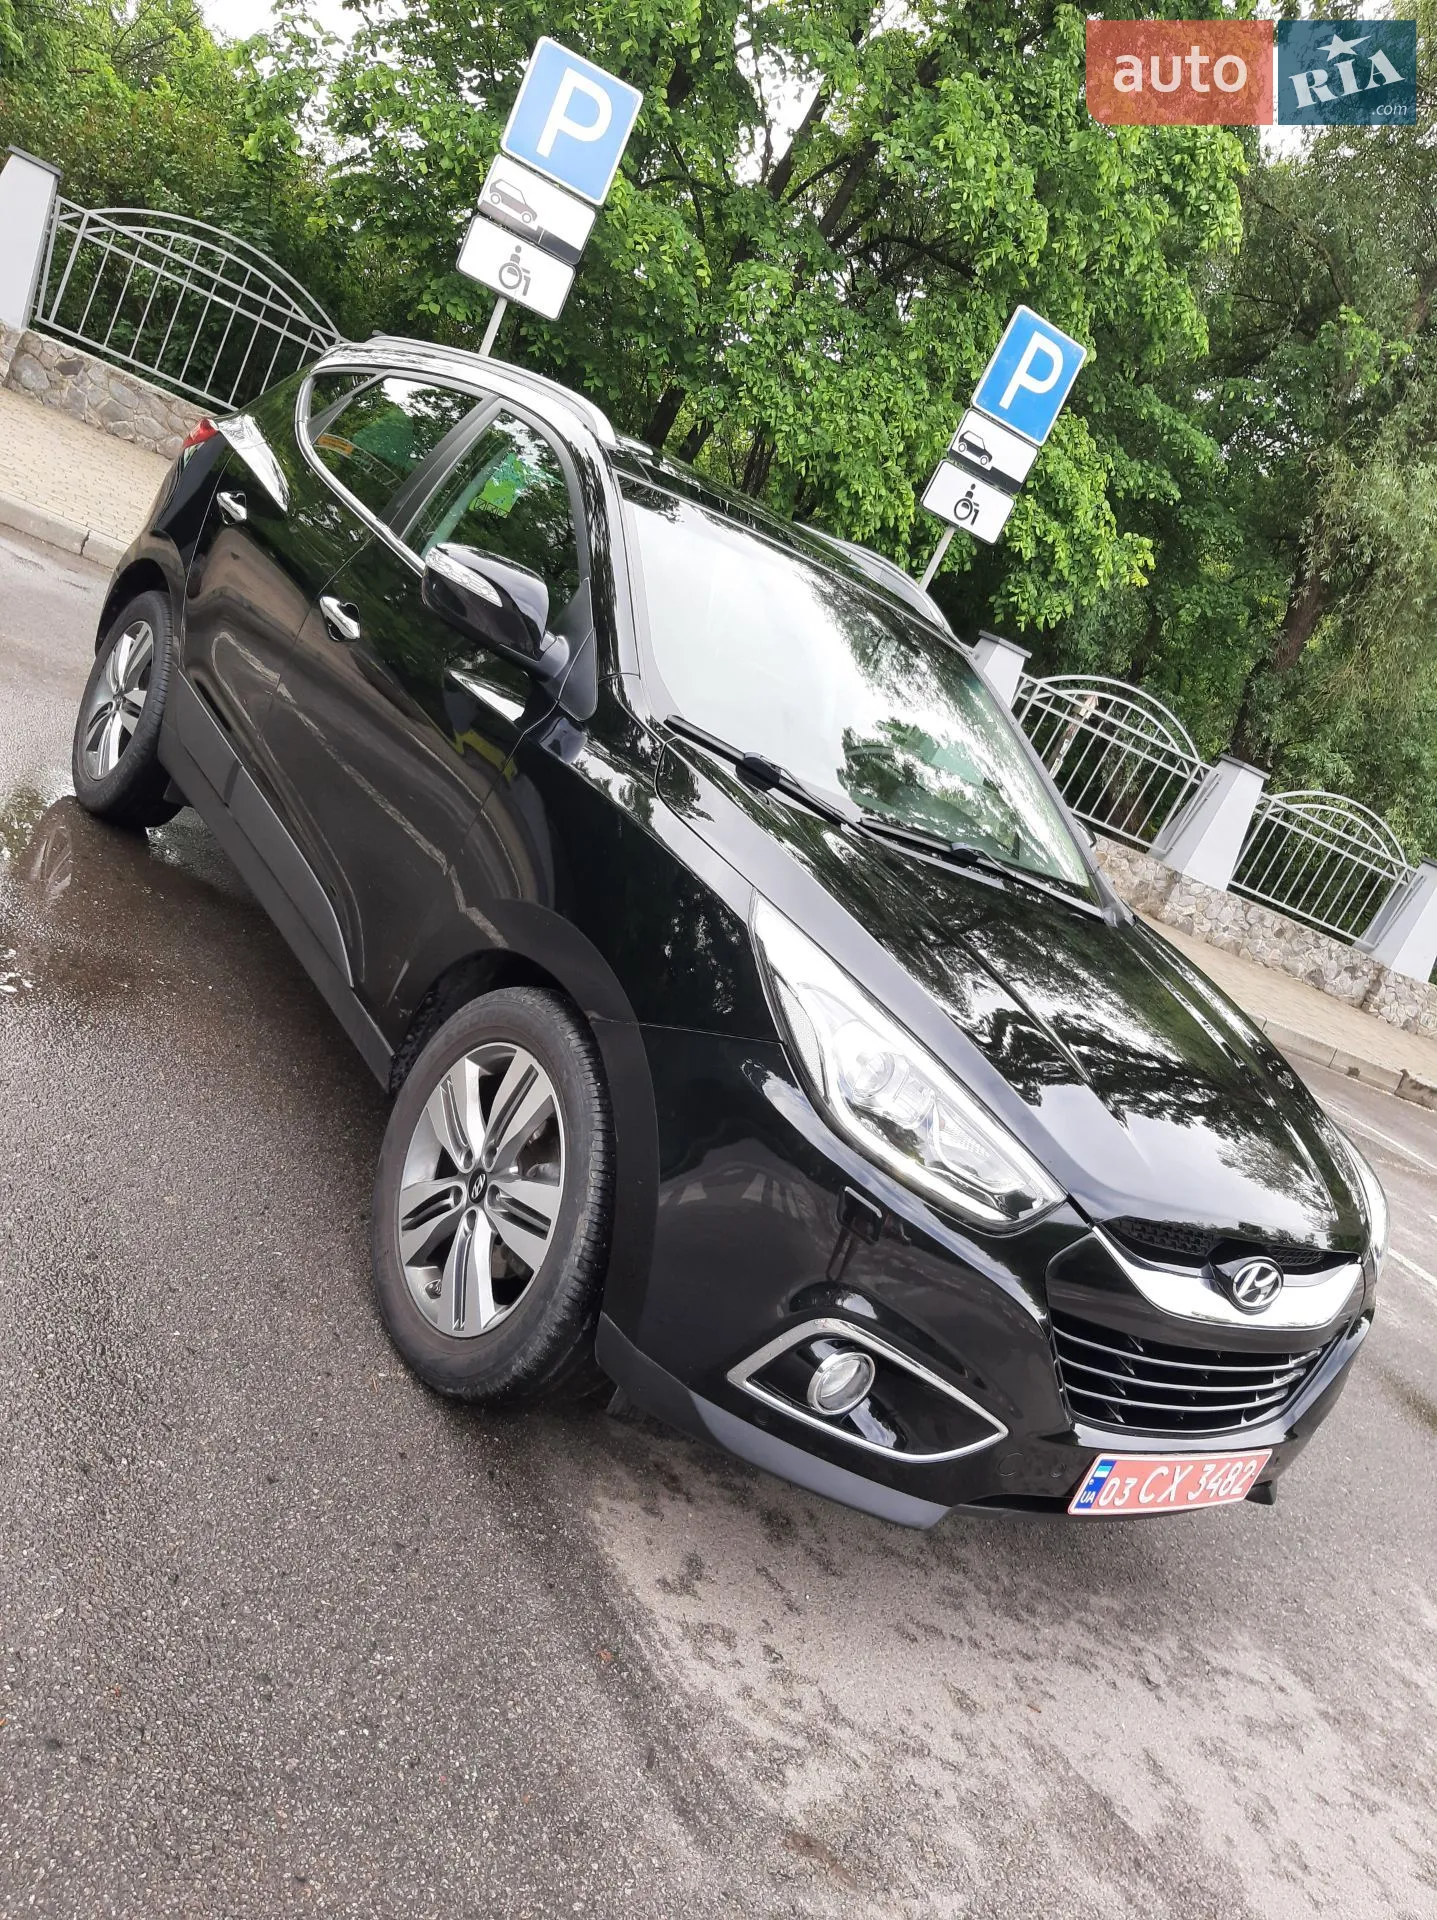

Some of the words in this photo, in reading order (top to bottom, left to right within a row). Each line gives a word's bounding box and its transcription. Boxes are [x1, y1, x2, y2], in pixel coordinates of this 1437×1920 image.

[536, 67, 613, 159] P
[999, 330, 1064, 410] P
[1080, 1491, 1096, 1503] UA
[1098, 1477, 1138, 1506] 03
[1138, 1465, 1194, 1504] CX
[1187, 1459, 1257, 1500] 3482
